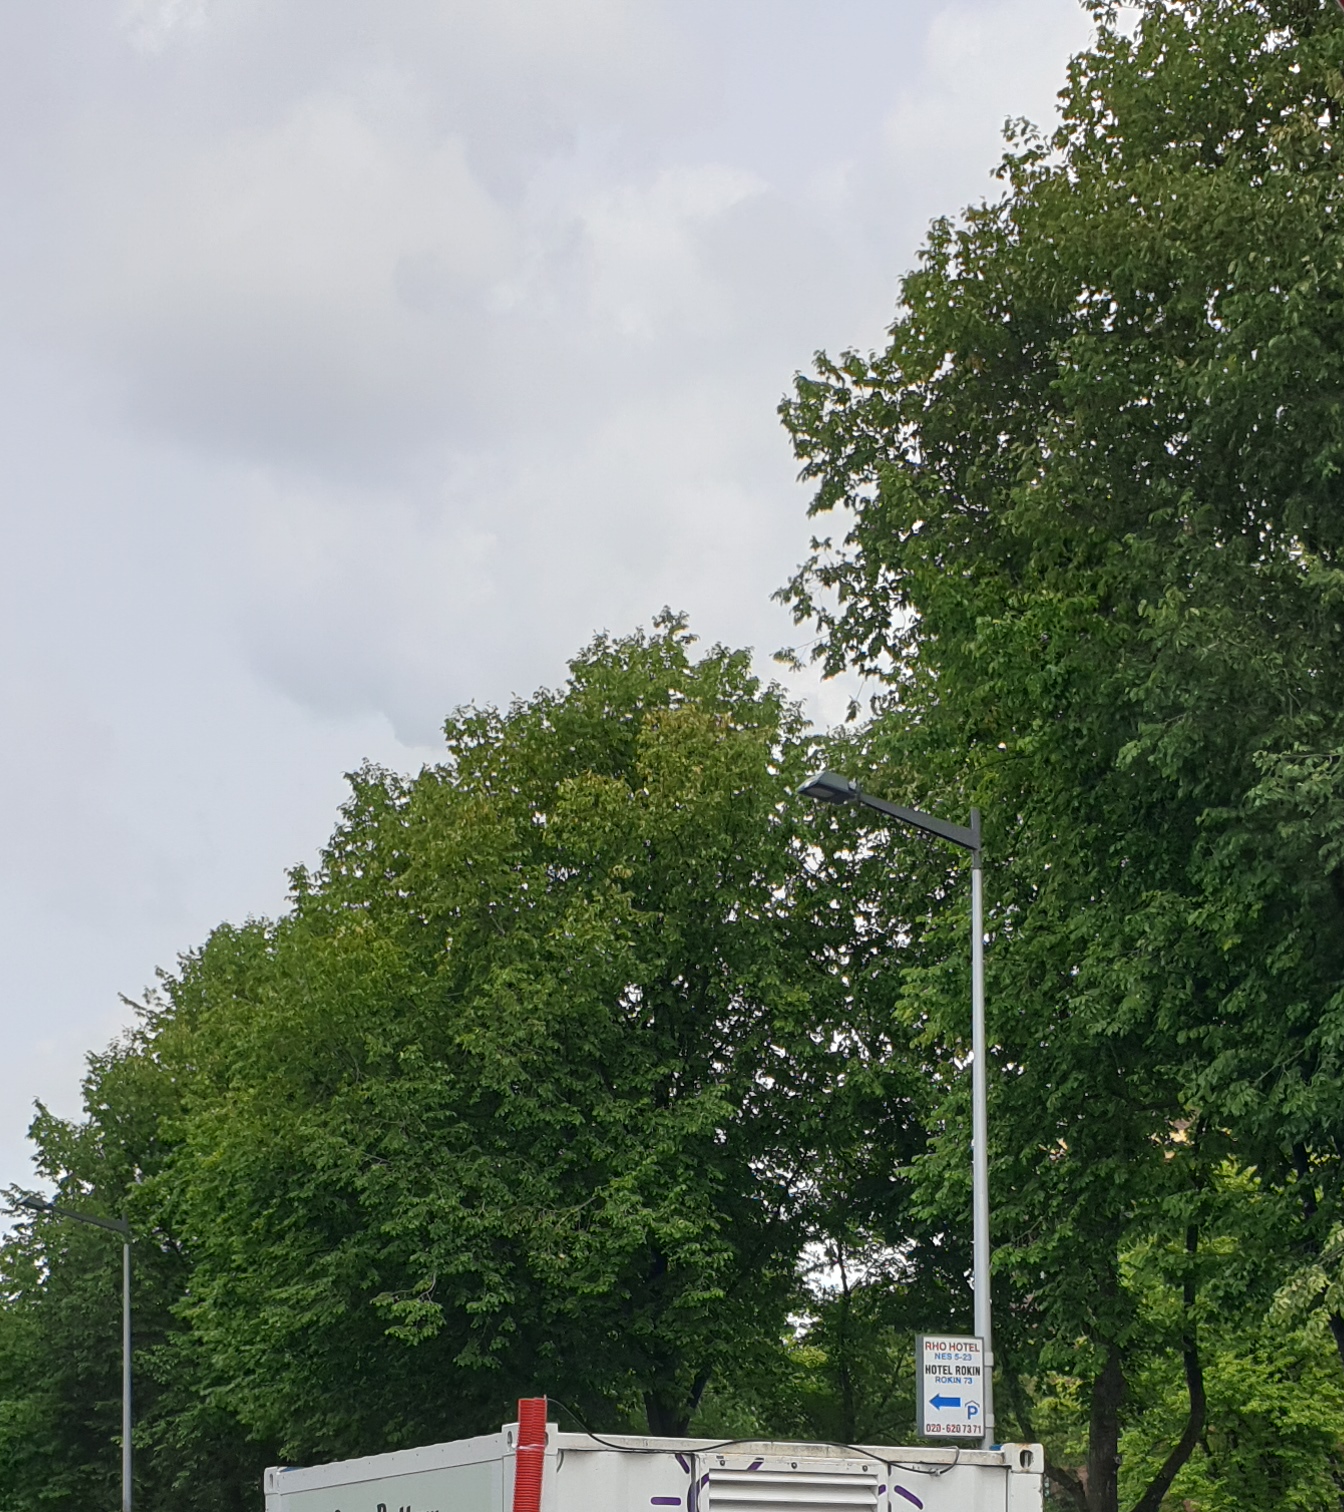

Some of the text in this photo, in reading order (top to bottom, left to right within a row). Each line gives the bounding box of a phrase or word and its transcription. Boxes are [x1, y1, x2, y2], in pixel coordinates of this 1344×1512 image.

[925, 1341, 980, 1352] RHO HOTEL
[954, 1353, 972, 1361] 5-23
[925, 1364, 980, 1376] HOTEL ROKIN
[935, 1376, 961, 1384] ROKIN
